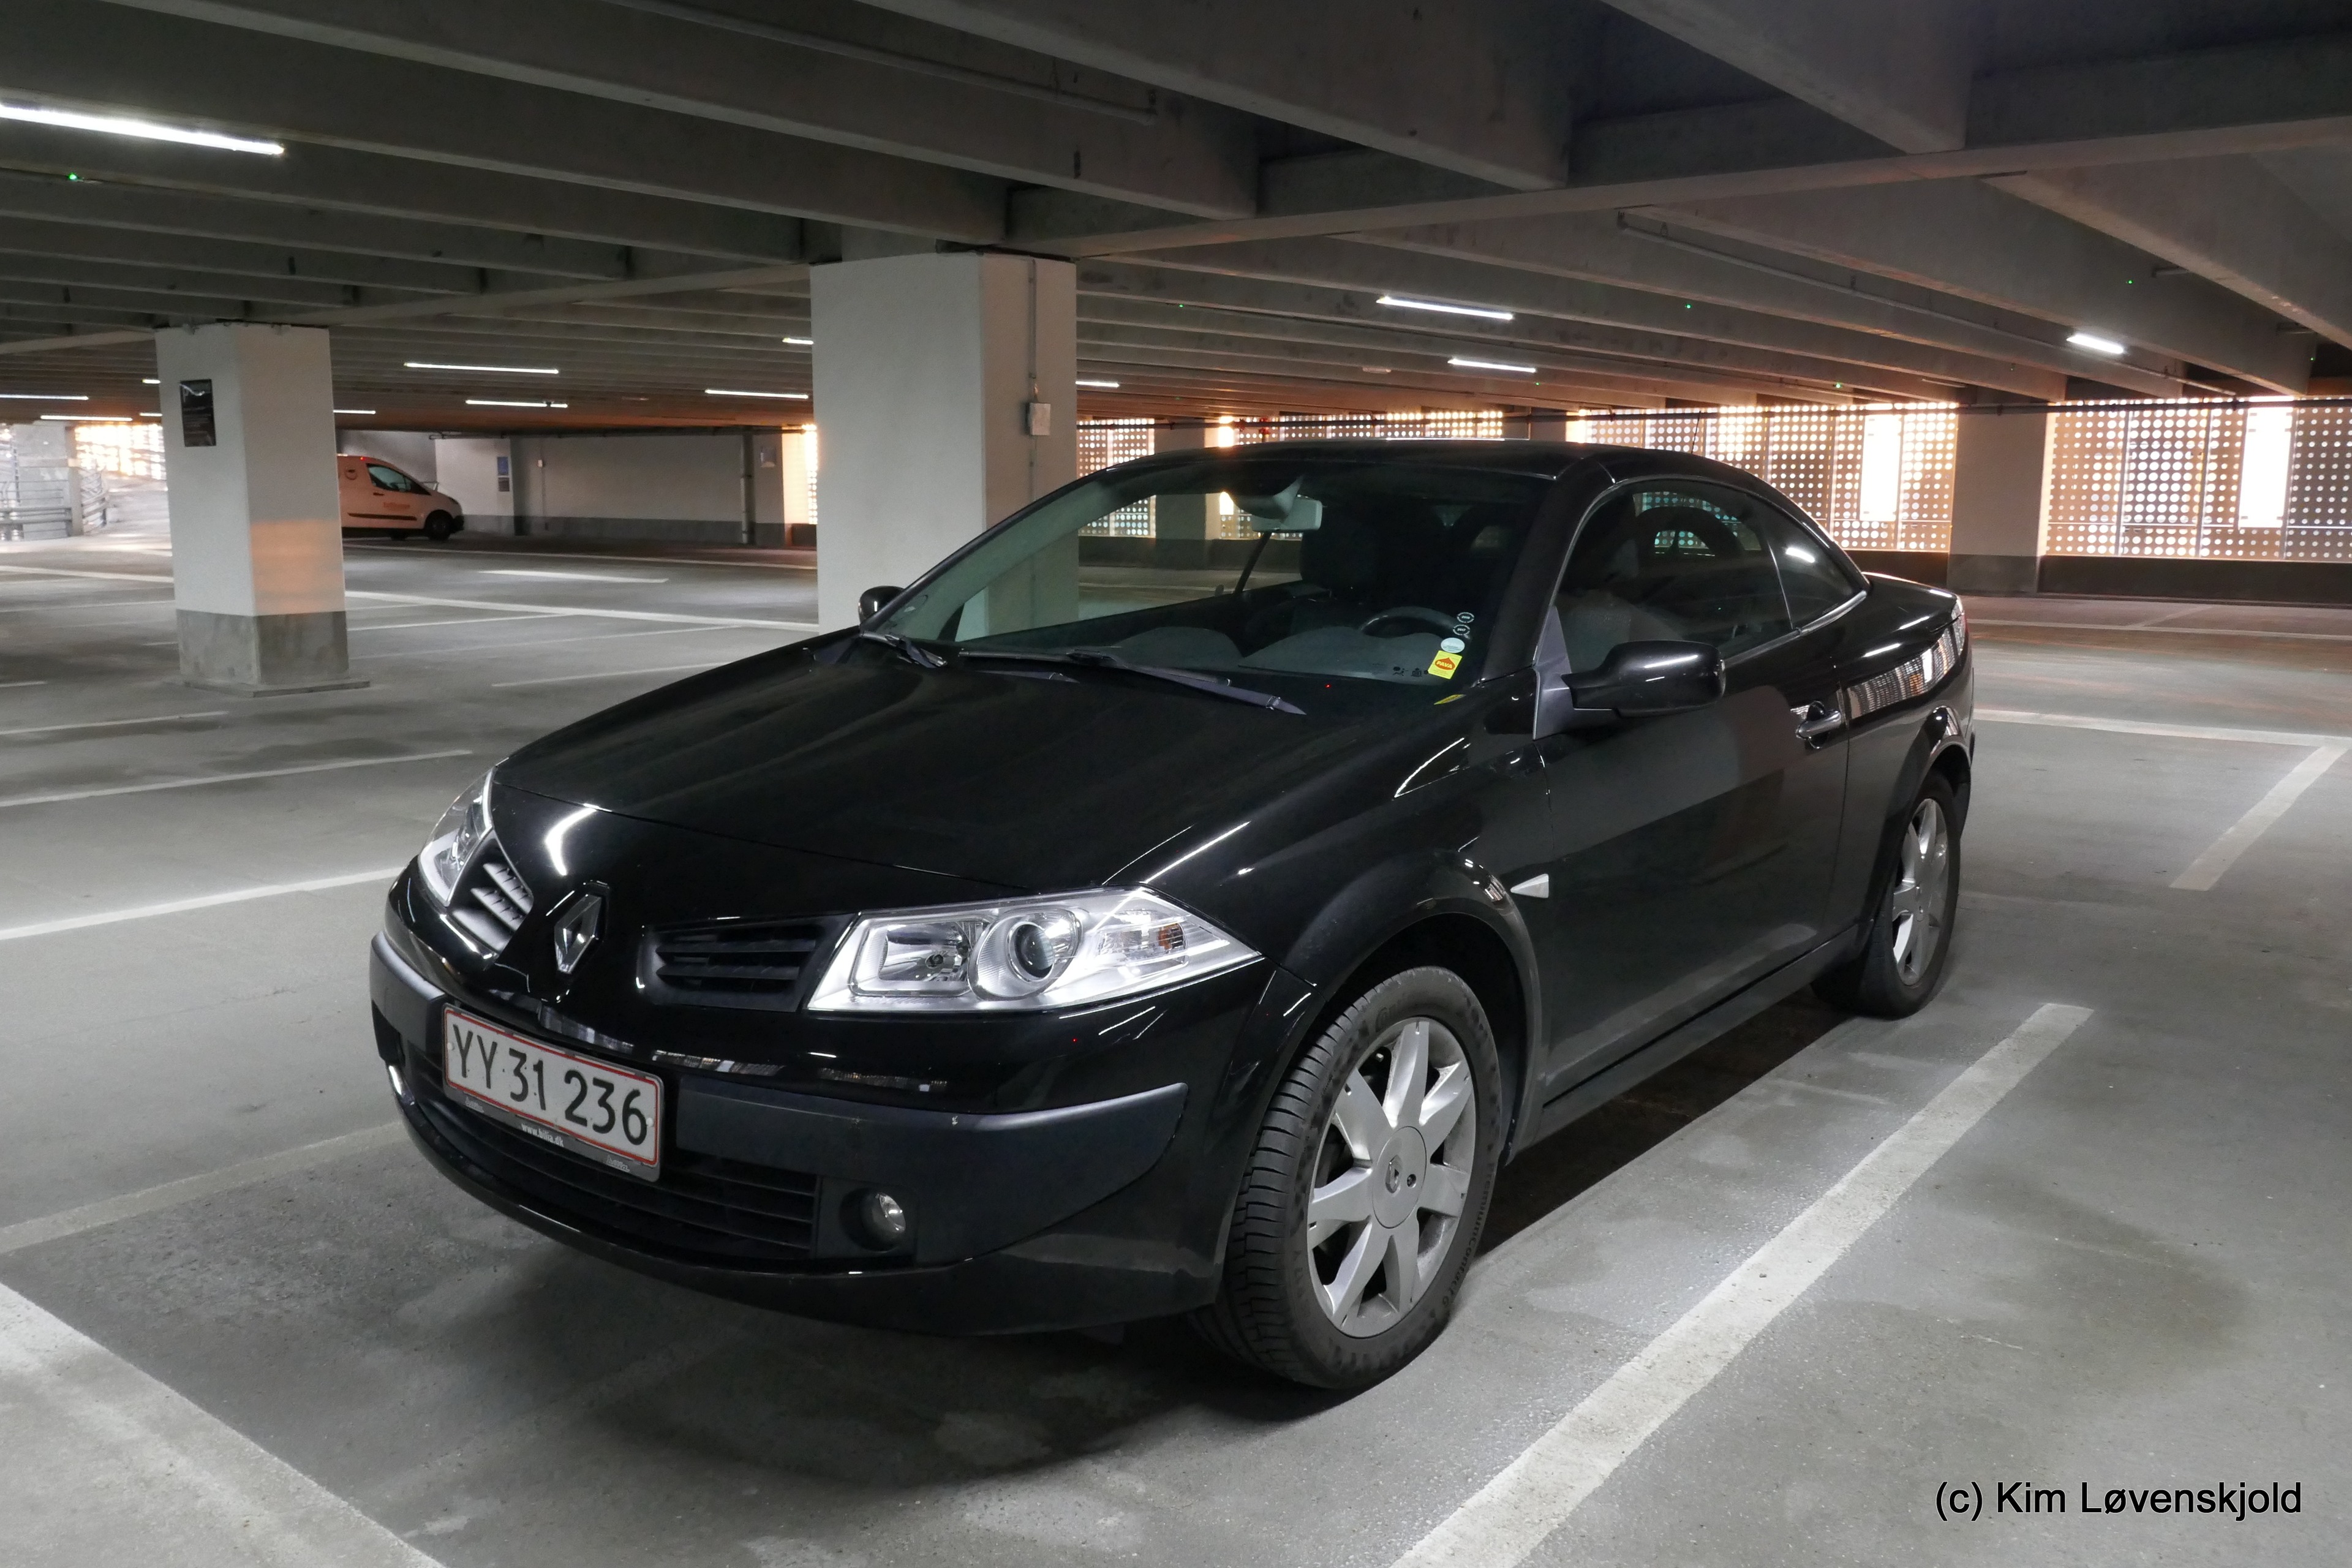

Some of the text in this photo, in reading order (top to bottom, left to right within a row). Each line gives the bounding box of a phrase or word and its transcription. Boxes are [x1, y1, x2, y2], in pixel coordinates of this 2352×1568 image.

[453, 1023, 647, 1146] YY 31 236
[521, 1123, 564, 1147] www.bilia.dk
